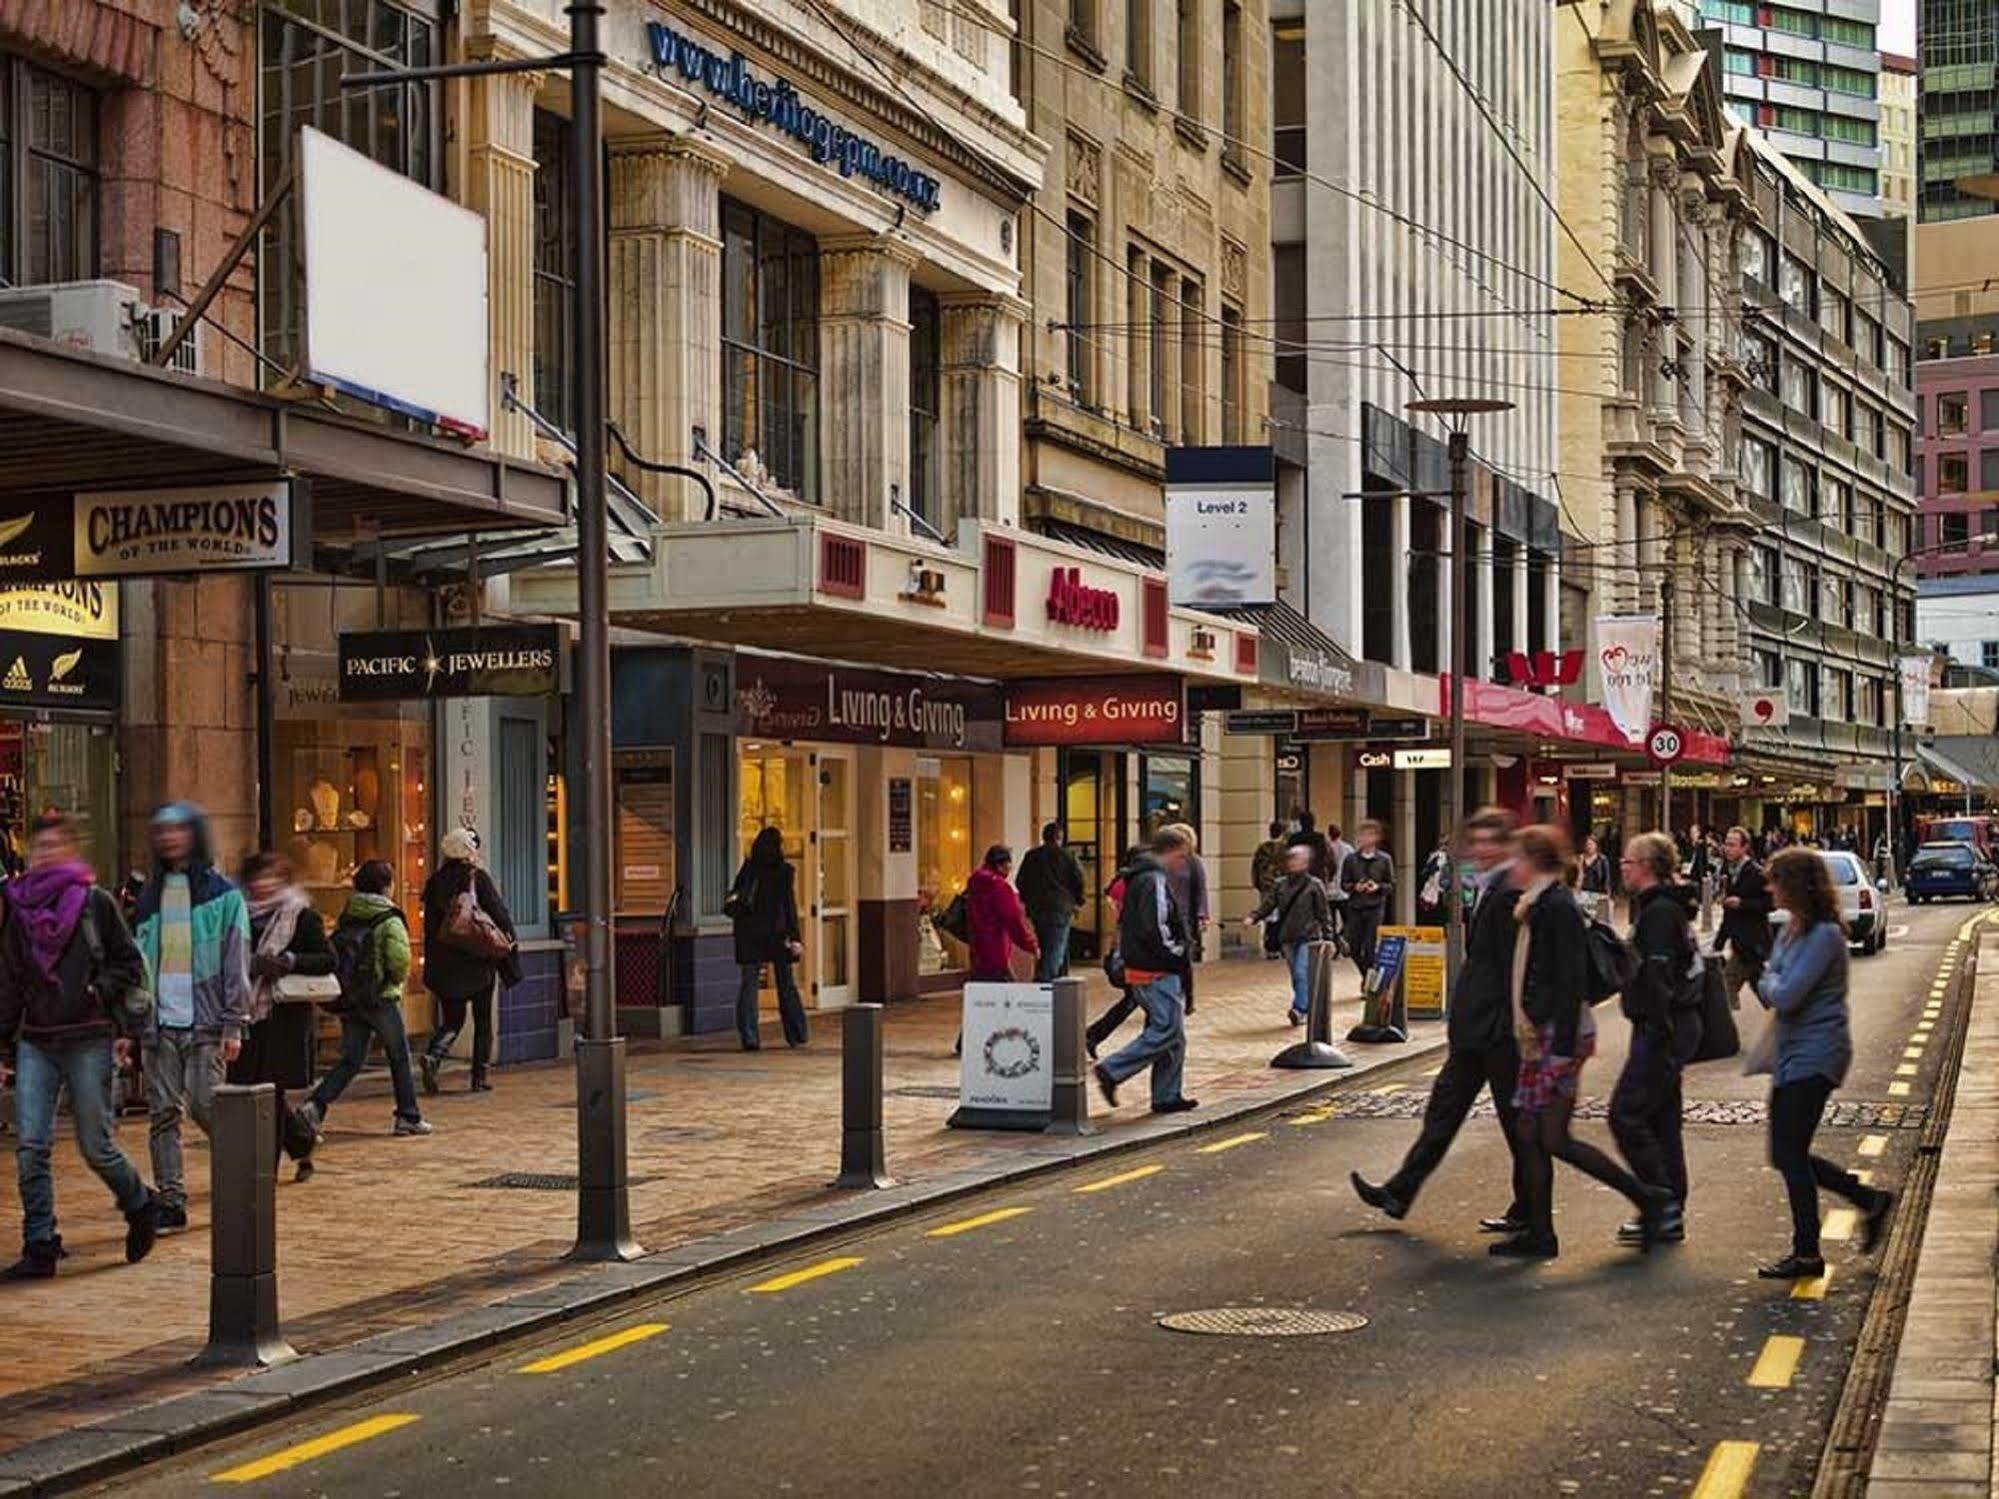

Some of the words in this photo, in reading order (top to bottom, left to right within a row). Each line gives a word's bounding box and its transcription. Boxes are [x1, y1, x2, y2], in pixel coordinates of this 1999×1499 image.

[1197, 500, 1235, 514] Level
[1238, 500, 1248, 514] 2
[88, 497, 278, 555] CHAMPIONS
[119, 547, 139, 560] OF
[150, 539, 179, 554] THE
[17, 600, 39, 612] THE
[346, 656, 416, 676] PACIFIC
[449, 649, 553, 675] JEWELLERS
[828, 674, 891, 741] Living
[894, 699, 906, 729] &
[909, 687, 966, 746] Giving
[1005, 699, 1078, 726] Living
[1084, 706, 1097, 719] &
[1102, 695, 1179, 724] Giving
[1655, 736, 1678, 752] 30
[1360, 753, 1391, 768] Cash
